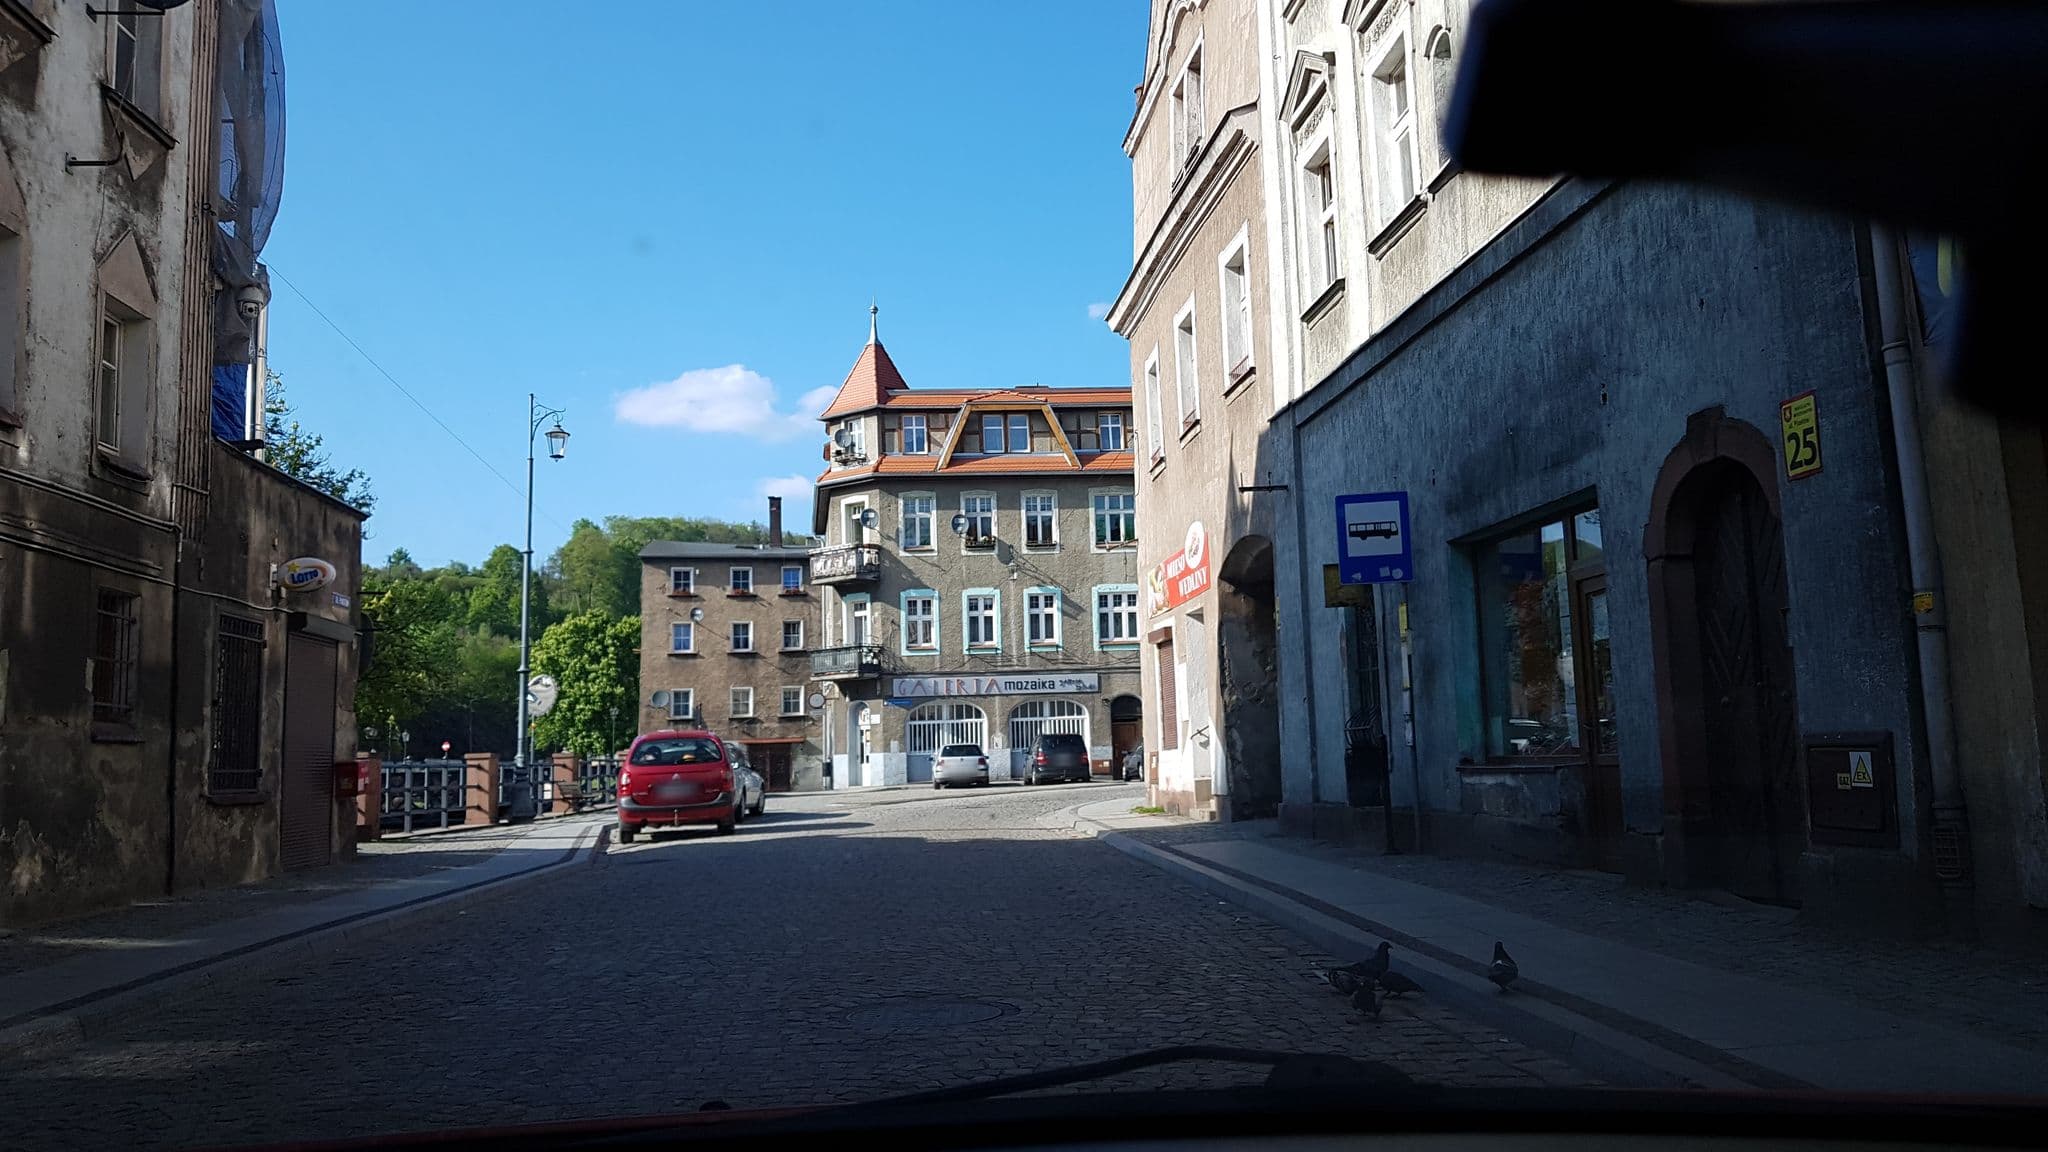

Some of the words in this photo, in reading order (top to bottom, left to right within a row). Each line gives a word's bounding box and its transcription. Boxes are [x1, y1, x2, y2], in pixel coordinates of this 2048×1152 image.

[1787, 427, 1817, 471] 25
[291, 569, 319, 584] LOTTO
[899, 677, 1001, 696] GALERIA
[1004, 679, 1055, 691] mozaika
